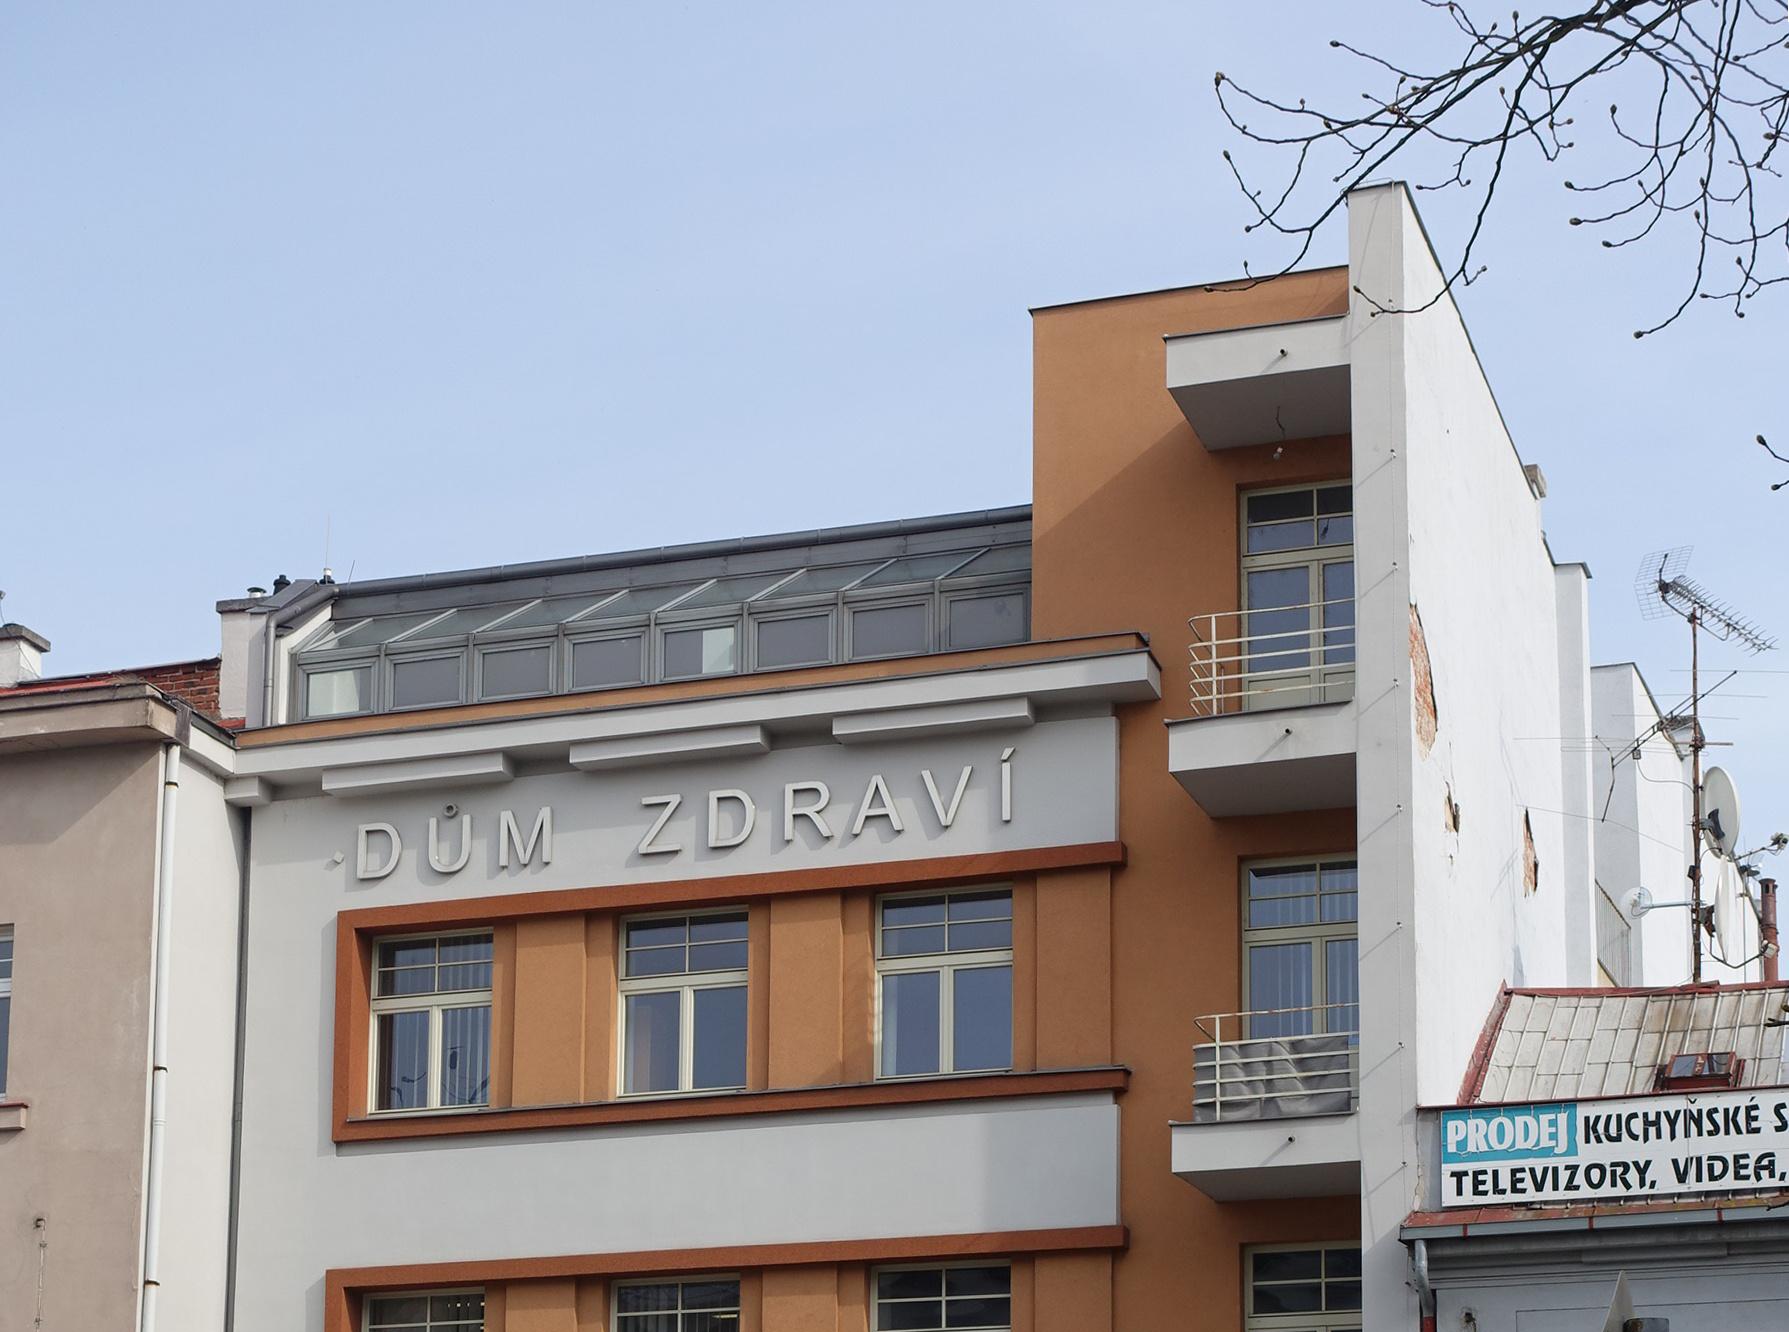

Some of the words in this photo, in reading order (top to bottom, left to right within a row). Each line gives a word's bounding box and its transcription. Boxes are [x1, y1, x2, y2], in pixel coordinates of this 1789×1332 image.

[356, 801, 553, 881] DŮM
[638, 747, 1015, 856] ZDRAVÍ
[1447, 1111, 1569, 1155] PRODEJ
[1584, 1096, 1762, 1145] KUCHYŇSKÉ
[1450, 1160, 1657, 1197] TELEVIZORY,
[1671, 1152, 1787, 1185] VIDEA,
